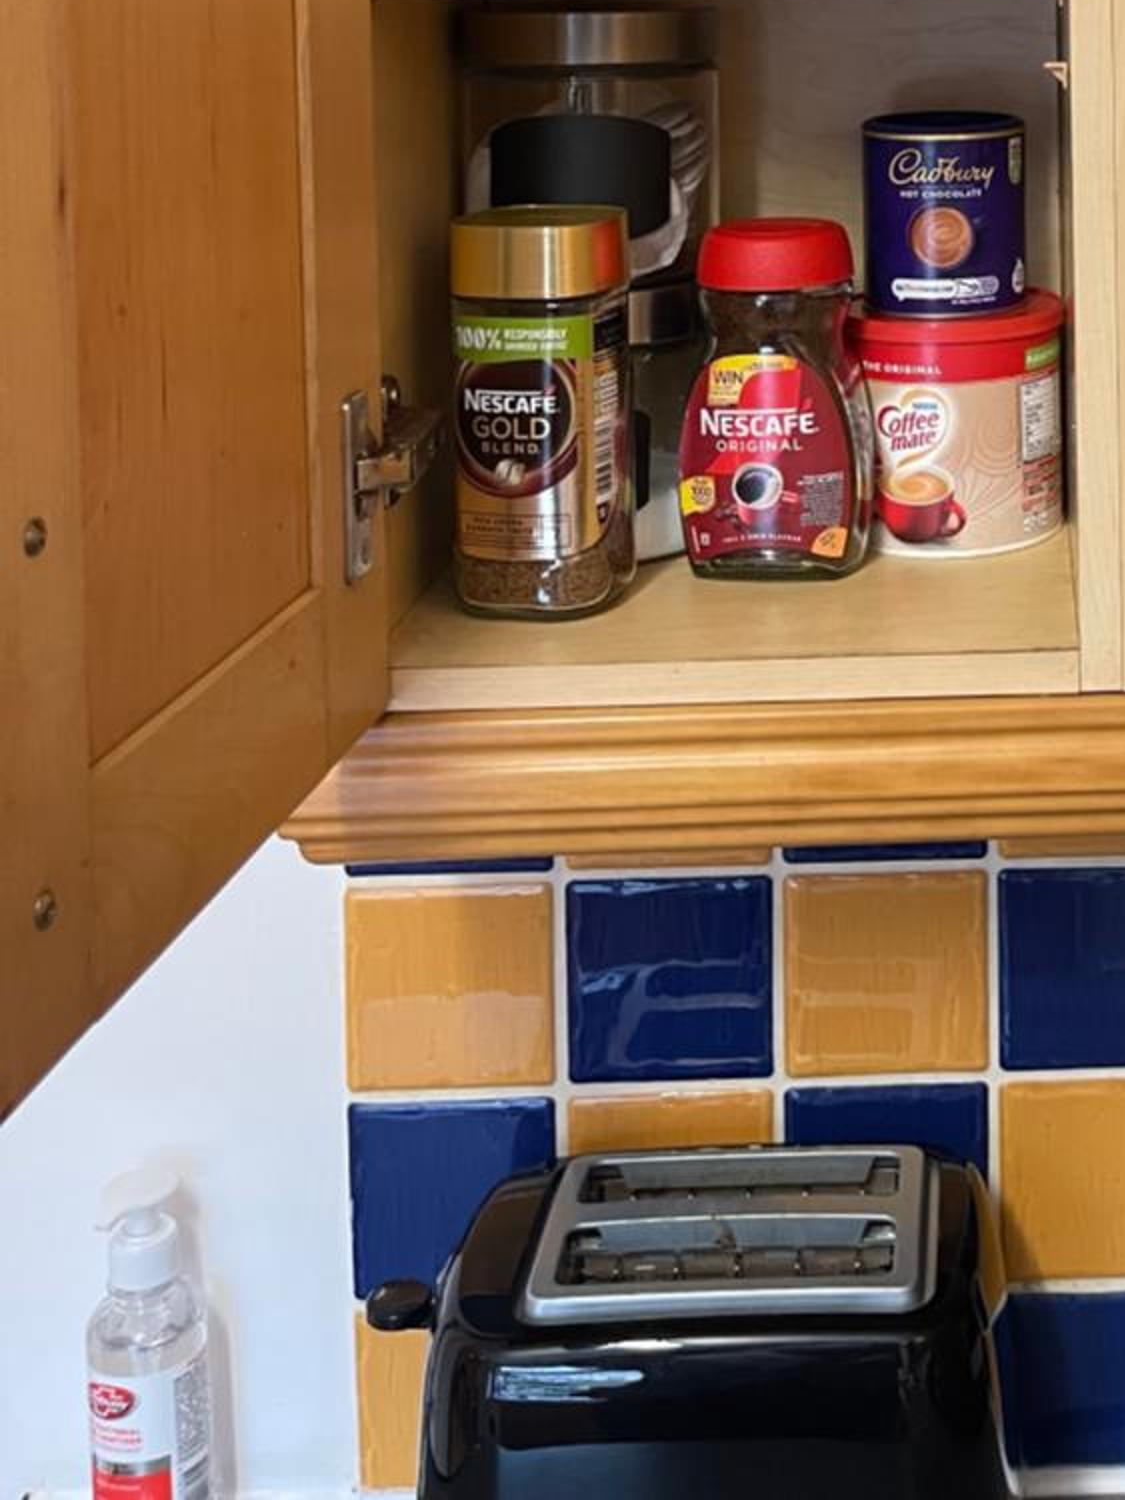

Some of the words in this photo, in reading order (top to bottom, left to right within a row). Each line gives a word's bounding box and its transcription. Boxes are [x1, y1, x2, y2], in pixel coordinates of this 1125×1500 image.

[888, 148, 994, 189] Cadbury
[900, 190, 918, 198] HOT
[921, 188, 982, 199] CHOCOLATE
[456, 326, 502, 350] 100%
[863, 361, 881, 372] THE
[883, 364, 943, 375] ORIGINAL
[714, 371, 743, 384] WIN
[472, 415, 551, 439] GOLD
[877, 405, 940, 437] Coffee
[481, 441, 539, 455] BLEND
[716, 438, 803, 453] ORIGINAL
[890, 430, 937, 452] mate
